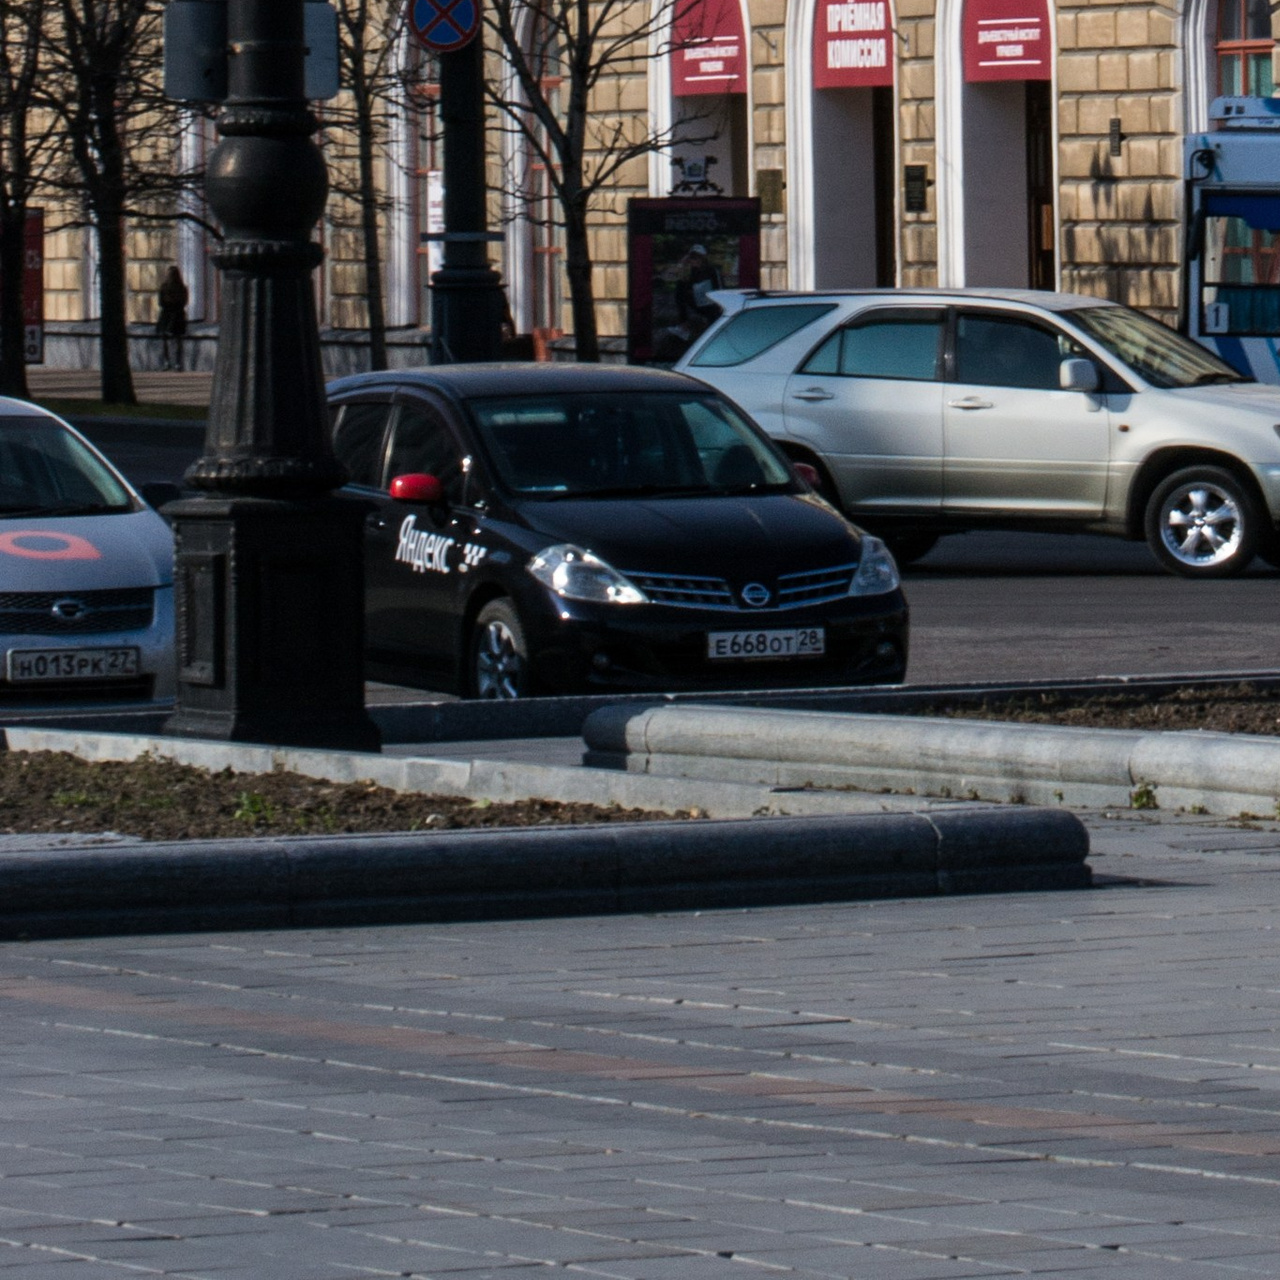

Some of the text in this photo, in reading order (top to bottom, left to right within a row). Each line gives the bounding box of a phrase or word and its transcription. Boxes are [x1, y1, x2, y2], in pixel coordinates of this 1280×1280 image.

[827, 38, 886, 68] КОМИССИЯ
[1214, 306, 1221, 328] 1
[395, 513, 455, 573] Яндекс
[798, 629, 819, 646] 28
[108, 651, 130, 668] 27
